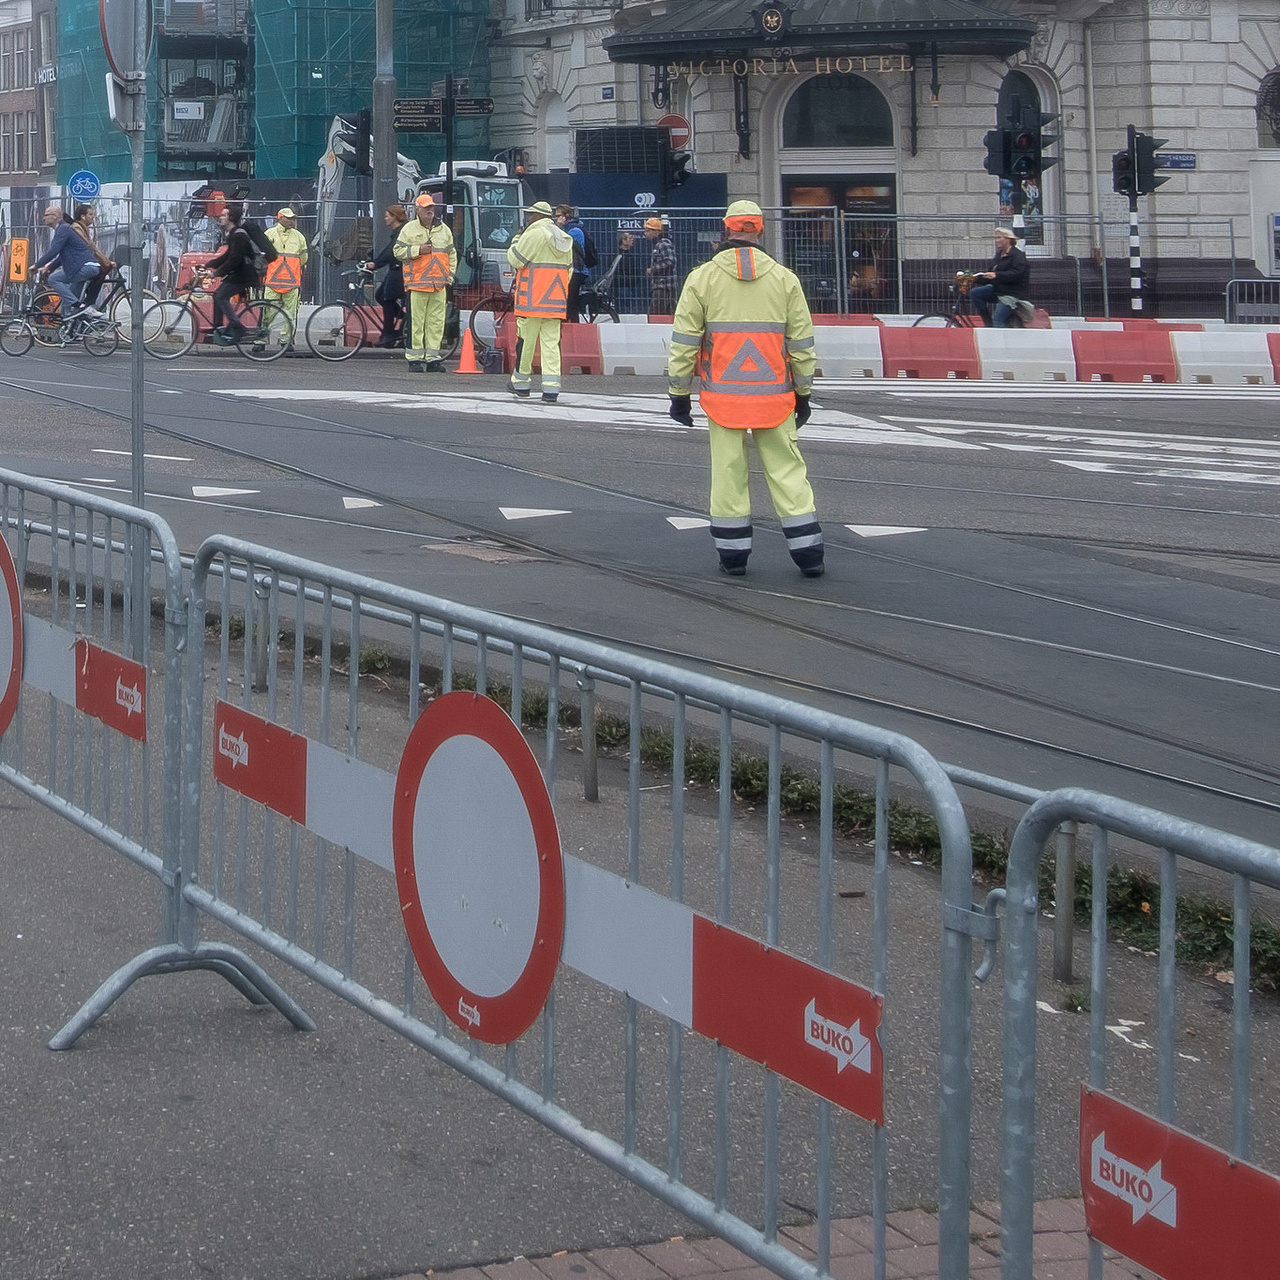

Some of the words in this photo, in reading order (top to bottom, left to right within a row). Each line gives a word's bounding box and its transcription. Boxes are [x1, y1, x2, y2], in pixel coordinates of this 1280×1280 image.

[38, 67, 57, 84] HOTEL
[671, 57, 801, 77] VICTORIA
[814, 54, 914, 75] HOTEL
[617, 219, 642, 229] Park
[118, 688, 135, 705] BUKO
[221, 736, 240, 756] BUKO
[809, 1019, 854, 1055] BUKO
[1099, 1156, 1154, 1204] BUKO
